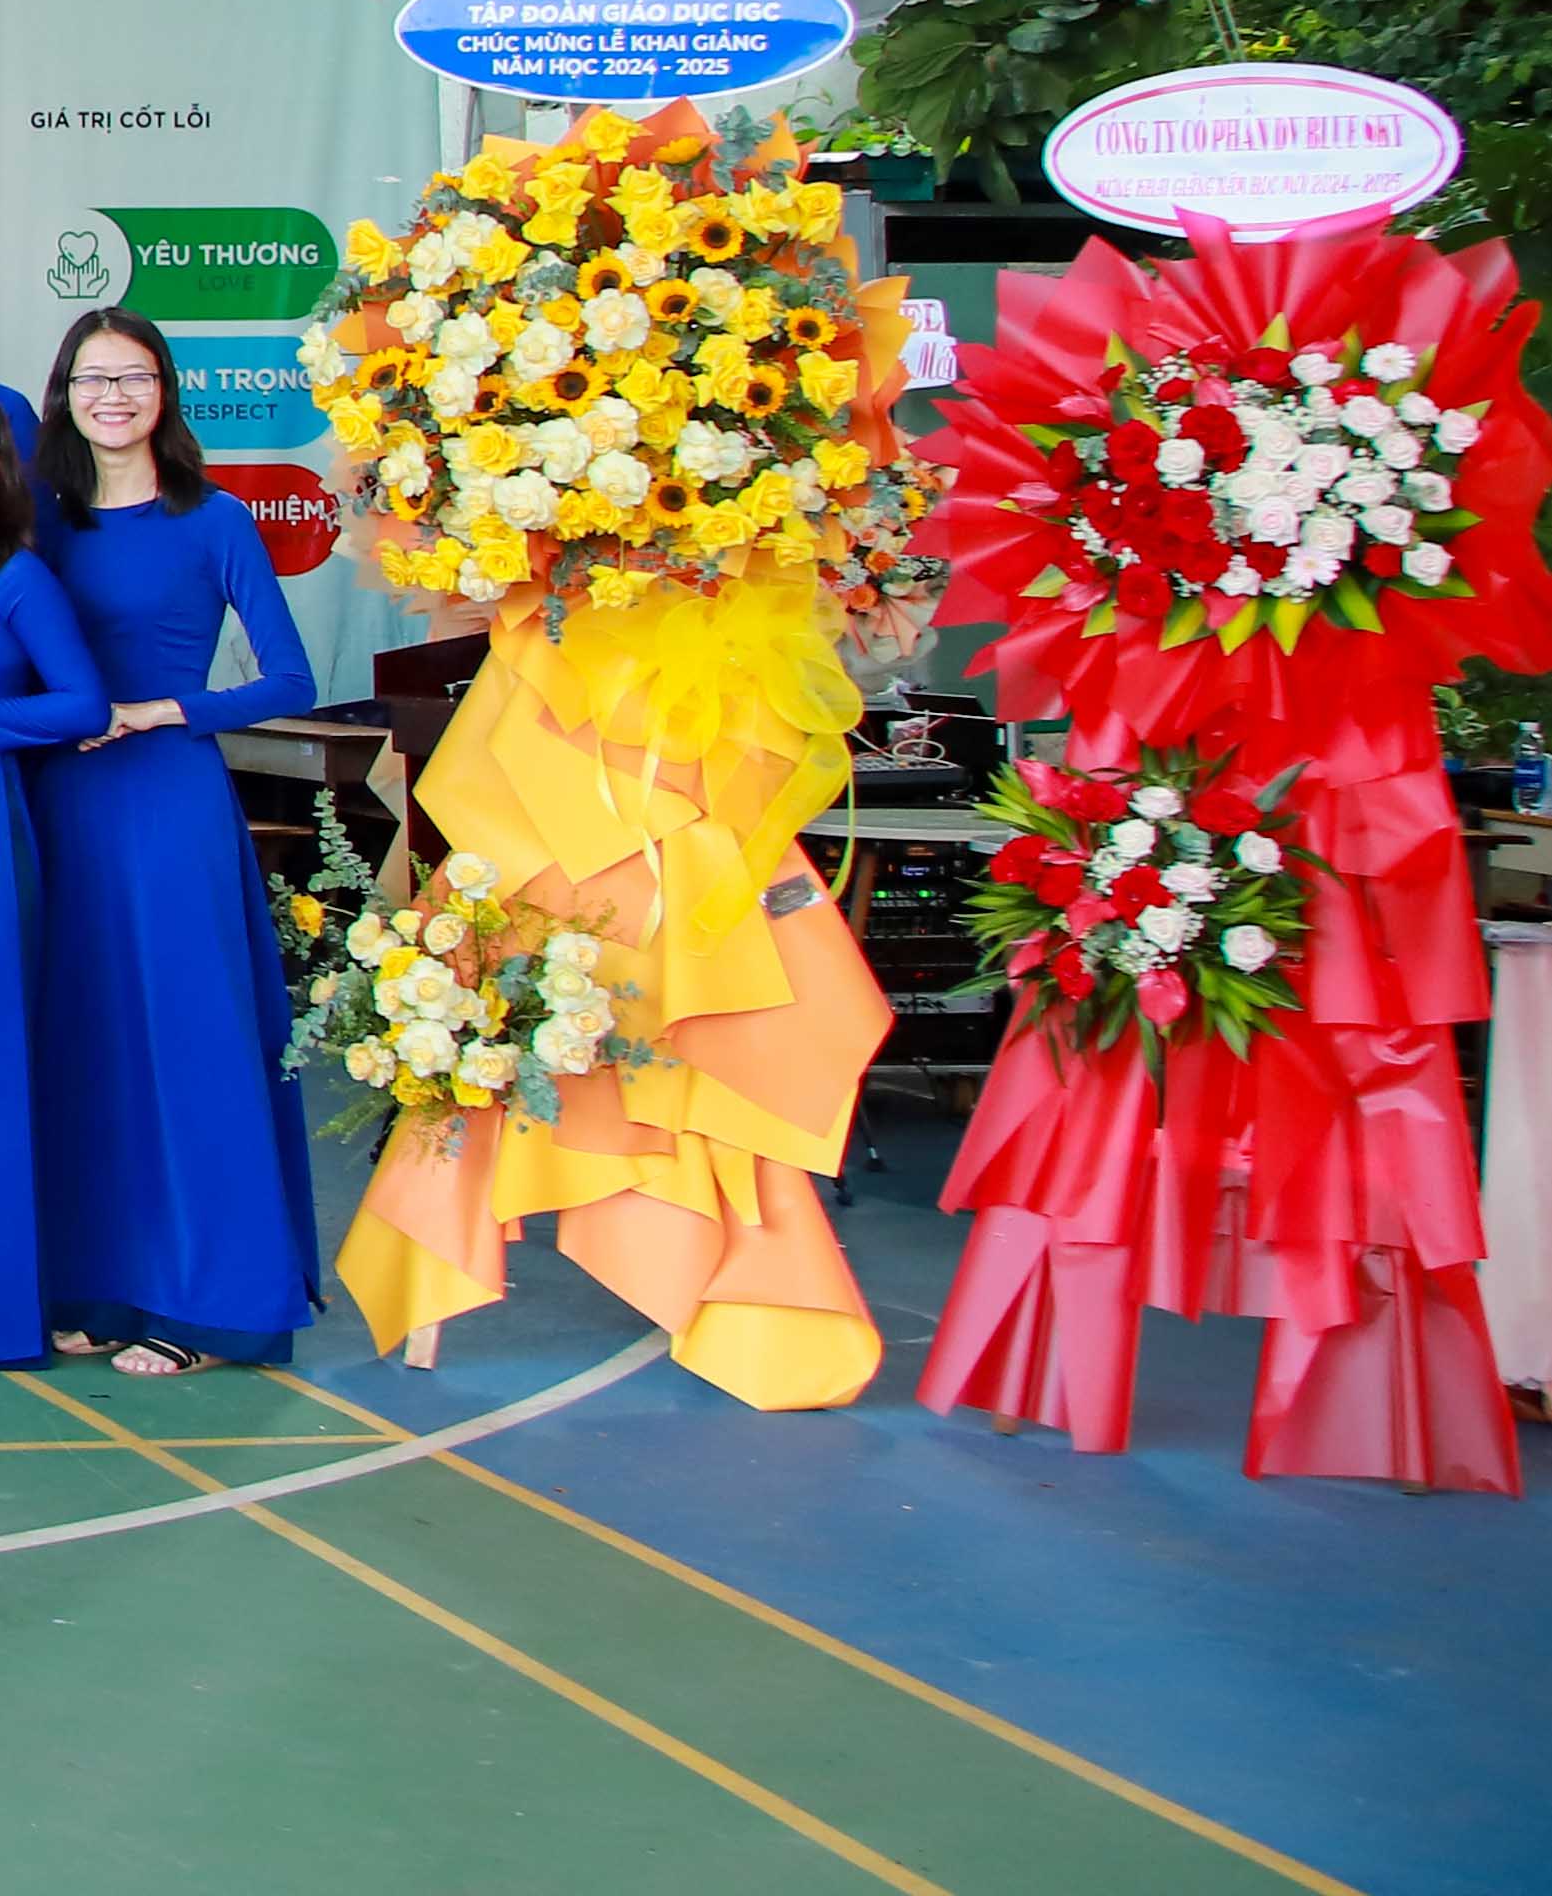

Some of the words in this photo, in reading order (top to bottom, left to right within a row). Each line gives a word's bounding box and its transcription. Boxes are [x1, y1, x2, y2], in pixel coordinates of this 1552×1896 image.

[468, 1, 516, 28] TẬP
[521, 0, 596, 24] ĐOÀN
[601, 0, 668, 23] GIÁO
[673, 3, 729, 27] DỤC
[734, 2, 783, 22] IGC
[456, 32, 520, 53] CHÚC
[524, 32, 593, 52] MỪNG
[598, 28, 626, 52] LỄ
[630, 34, 687, 52] KHAI
[692, 29, 768, 52] GIẢNG
[492, 55, 544, 76] NĂM
[549, 57, 599, 79] HỌC
[602, 57, 658, 76] 2024
[674, 57, 732, 76] 2025
[30, 107, 70, 129] GIÁ
[77, 111, 112, 134] TRỊ
[120, 105, 166, 129] CỐT
[174, 103, 211, 129] LỖI
[135, 239, 191, 267] YÊU
[199, 240, 320, 266] THƯƠNG
[199, 274, 255, 291] LOVE
[182, 403, 278, 421] RESPECT
